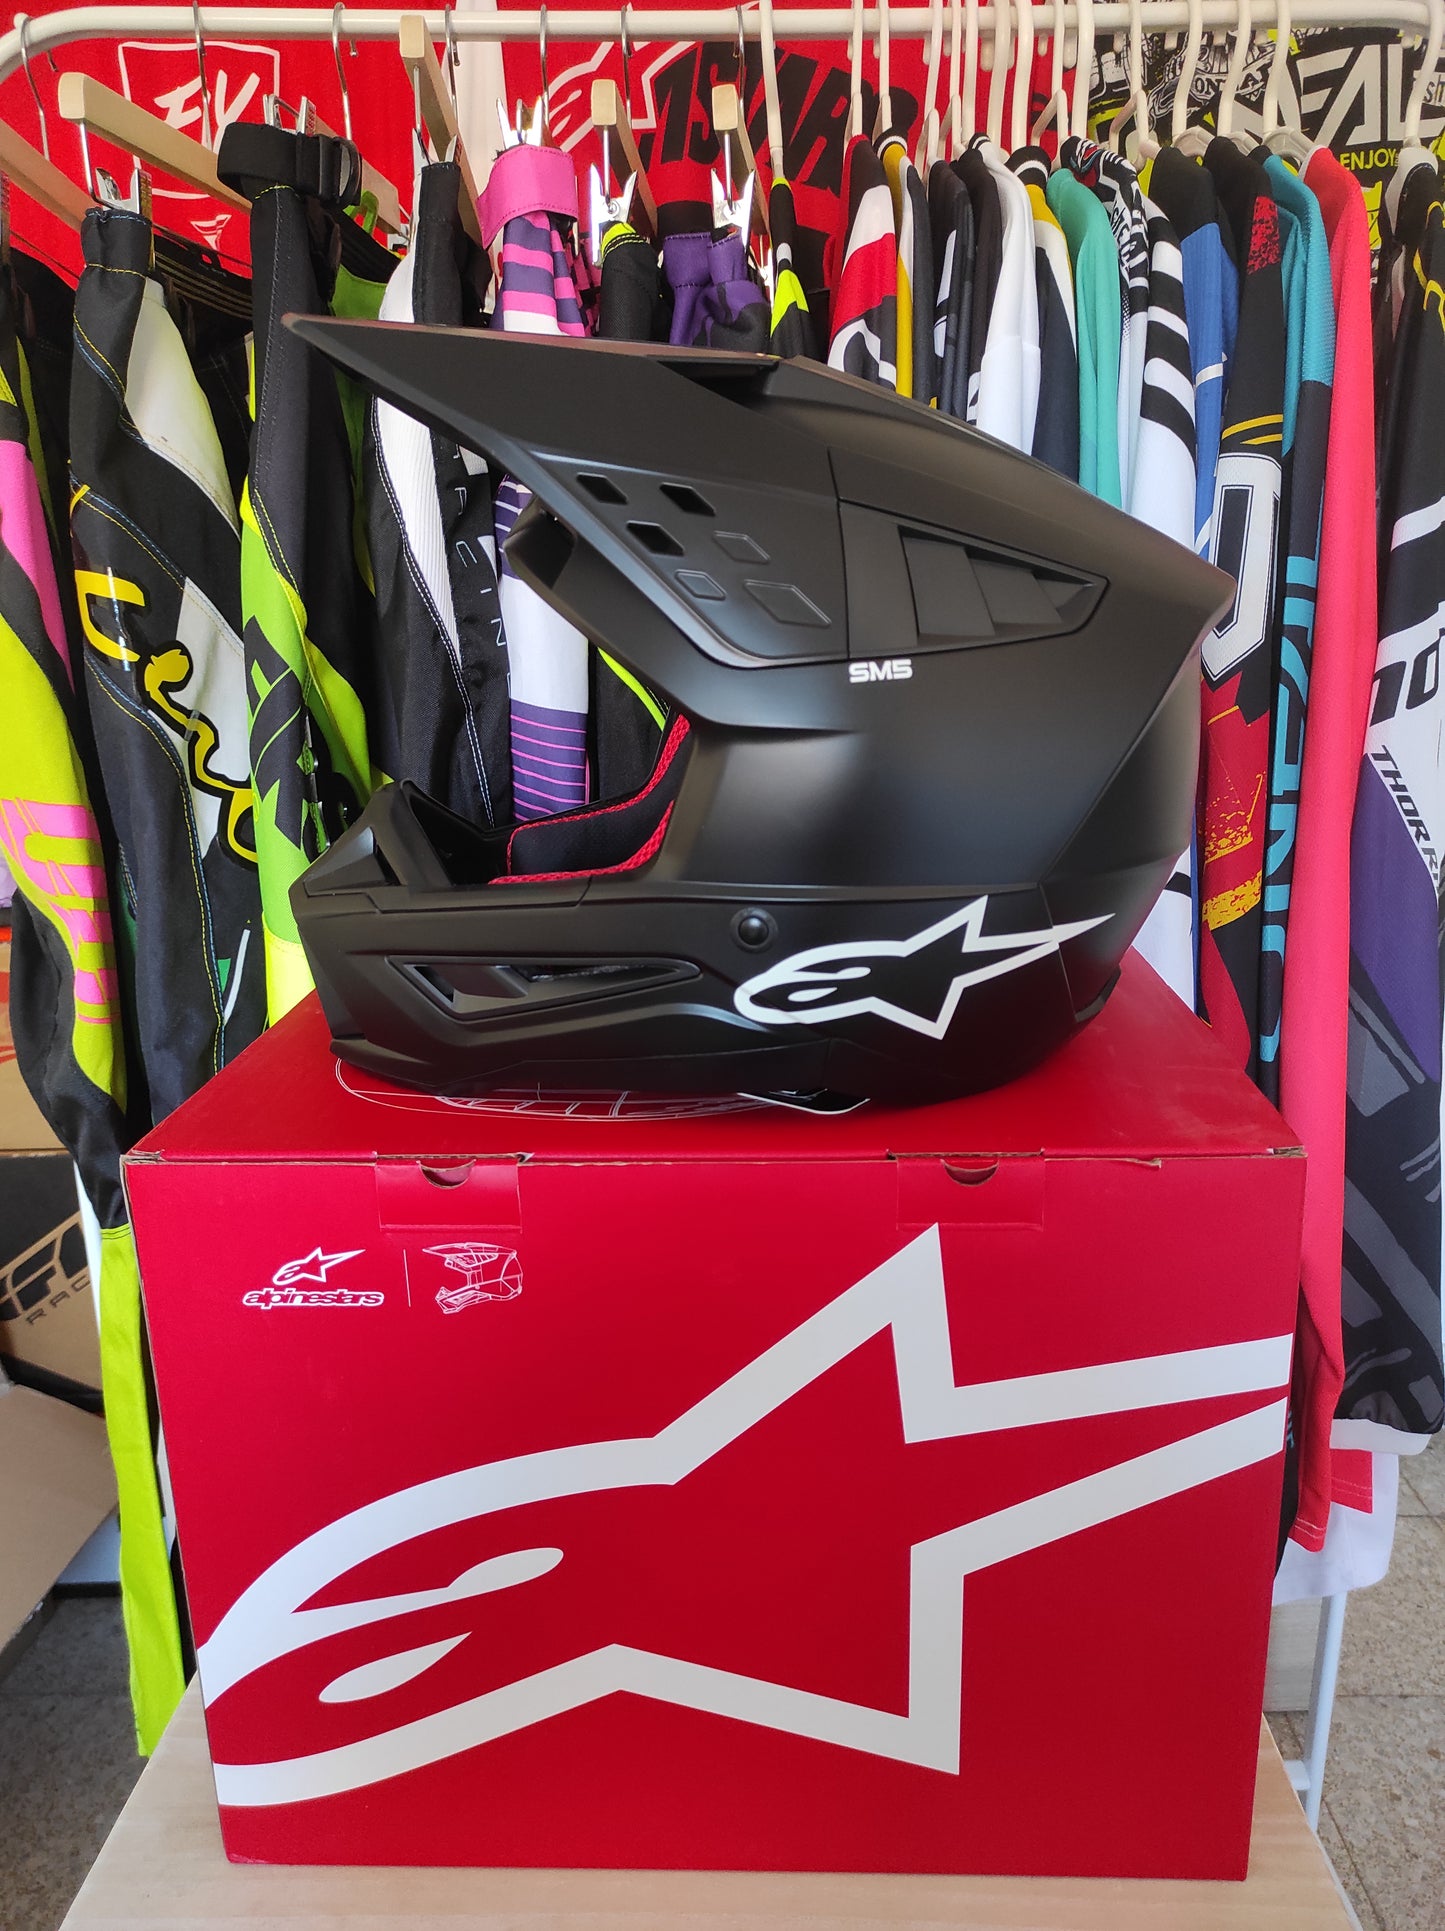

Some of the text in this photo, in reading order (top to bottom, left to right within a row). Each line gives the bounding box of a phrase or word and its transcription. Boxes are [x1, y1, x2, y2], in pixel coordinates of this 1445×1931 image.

[1340, 148, 1397, 170] ENJOY
[848, 658, 913, 684] SM5
[1370, 745, 1431, 844] THOR
[242, 1288, 385, 1310] alpinestars
